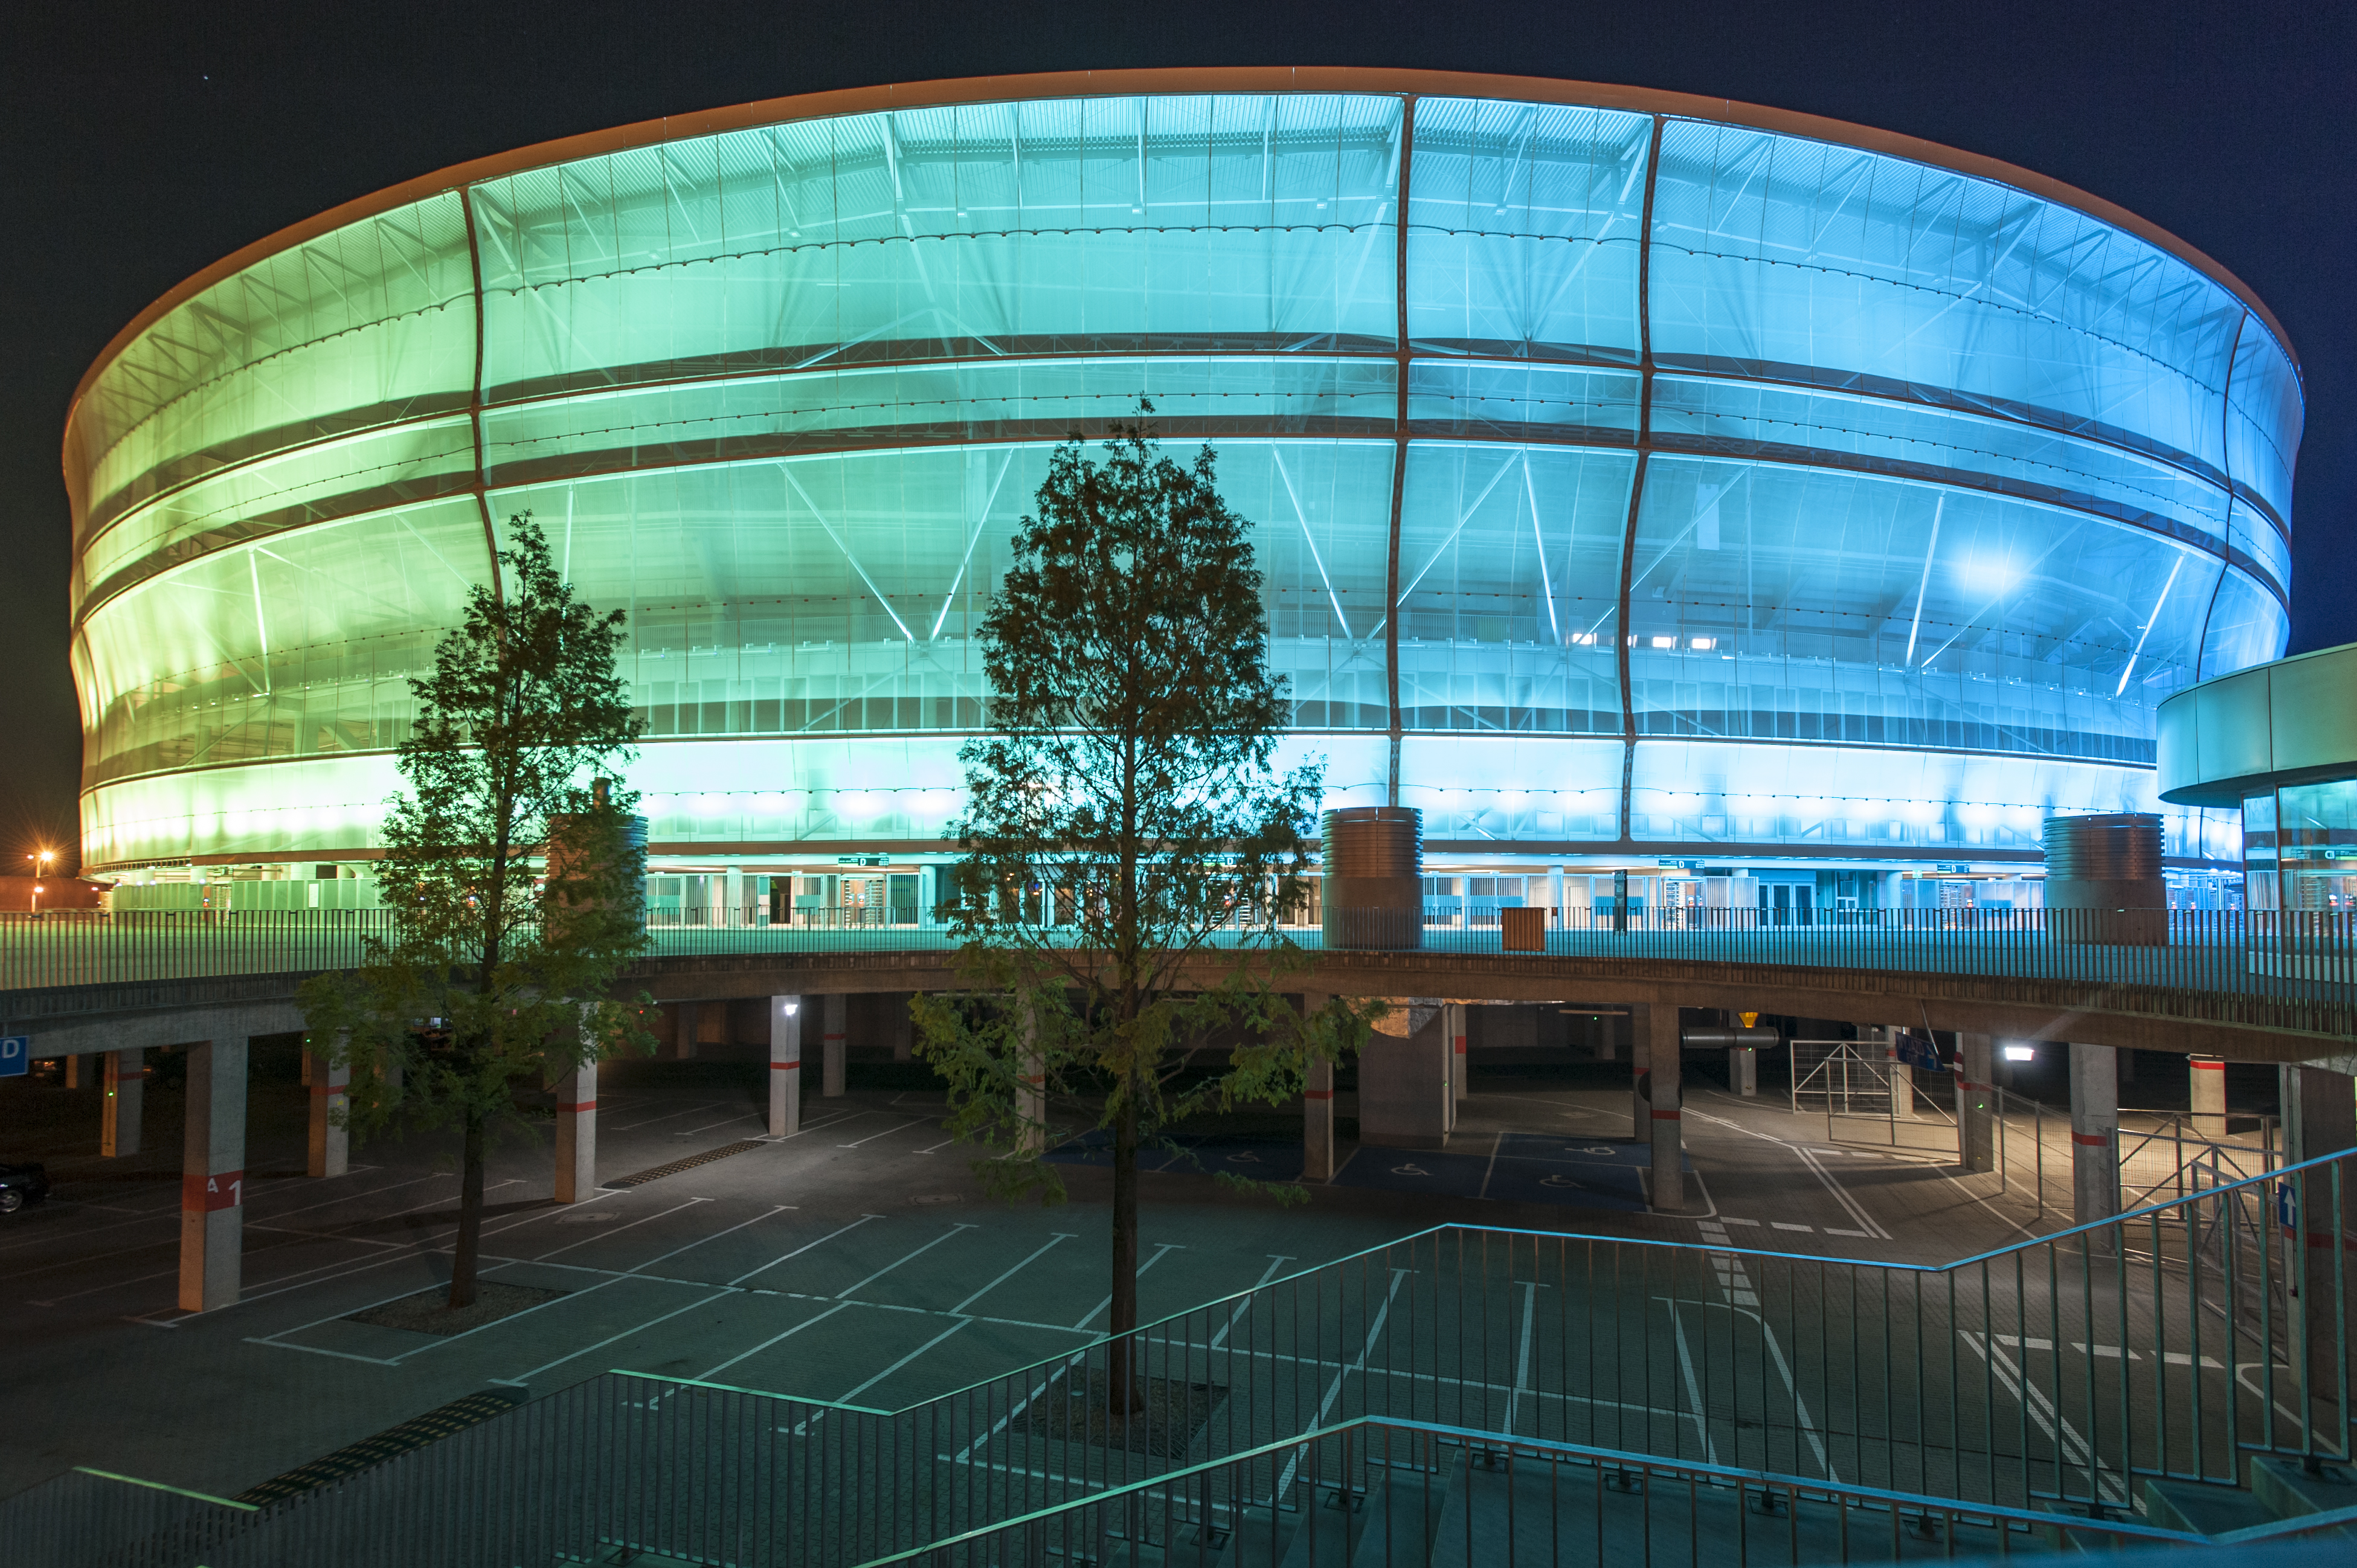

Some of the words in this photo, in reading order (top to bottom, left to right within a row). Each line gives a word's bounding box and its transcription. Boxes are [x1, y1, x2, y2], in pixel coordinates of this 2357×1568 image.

[0, 1039, 20, 1058] D
[207, 1178, 219, 1193] A
[228, 1180, 241, 1206] 1
